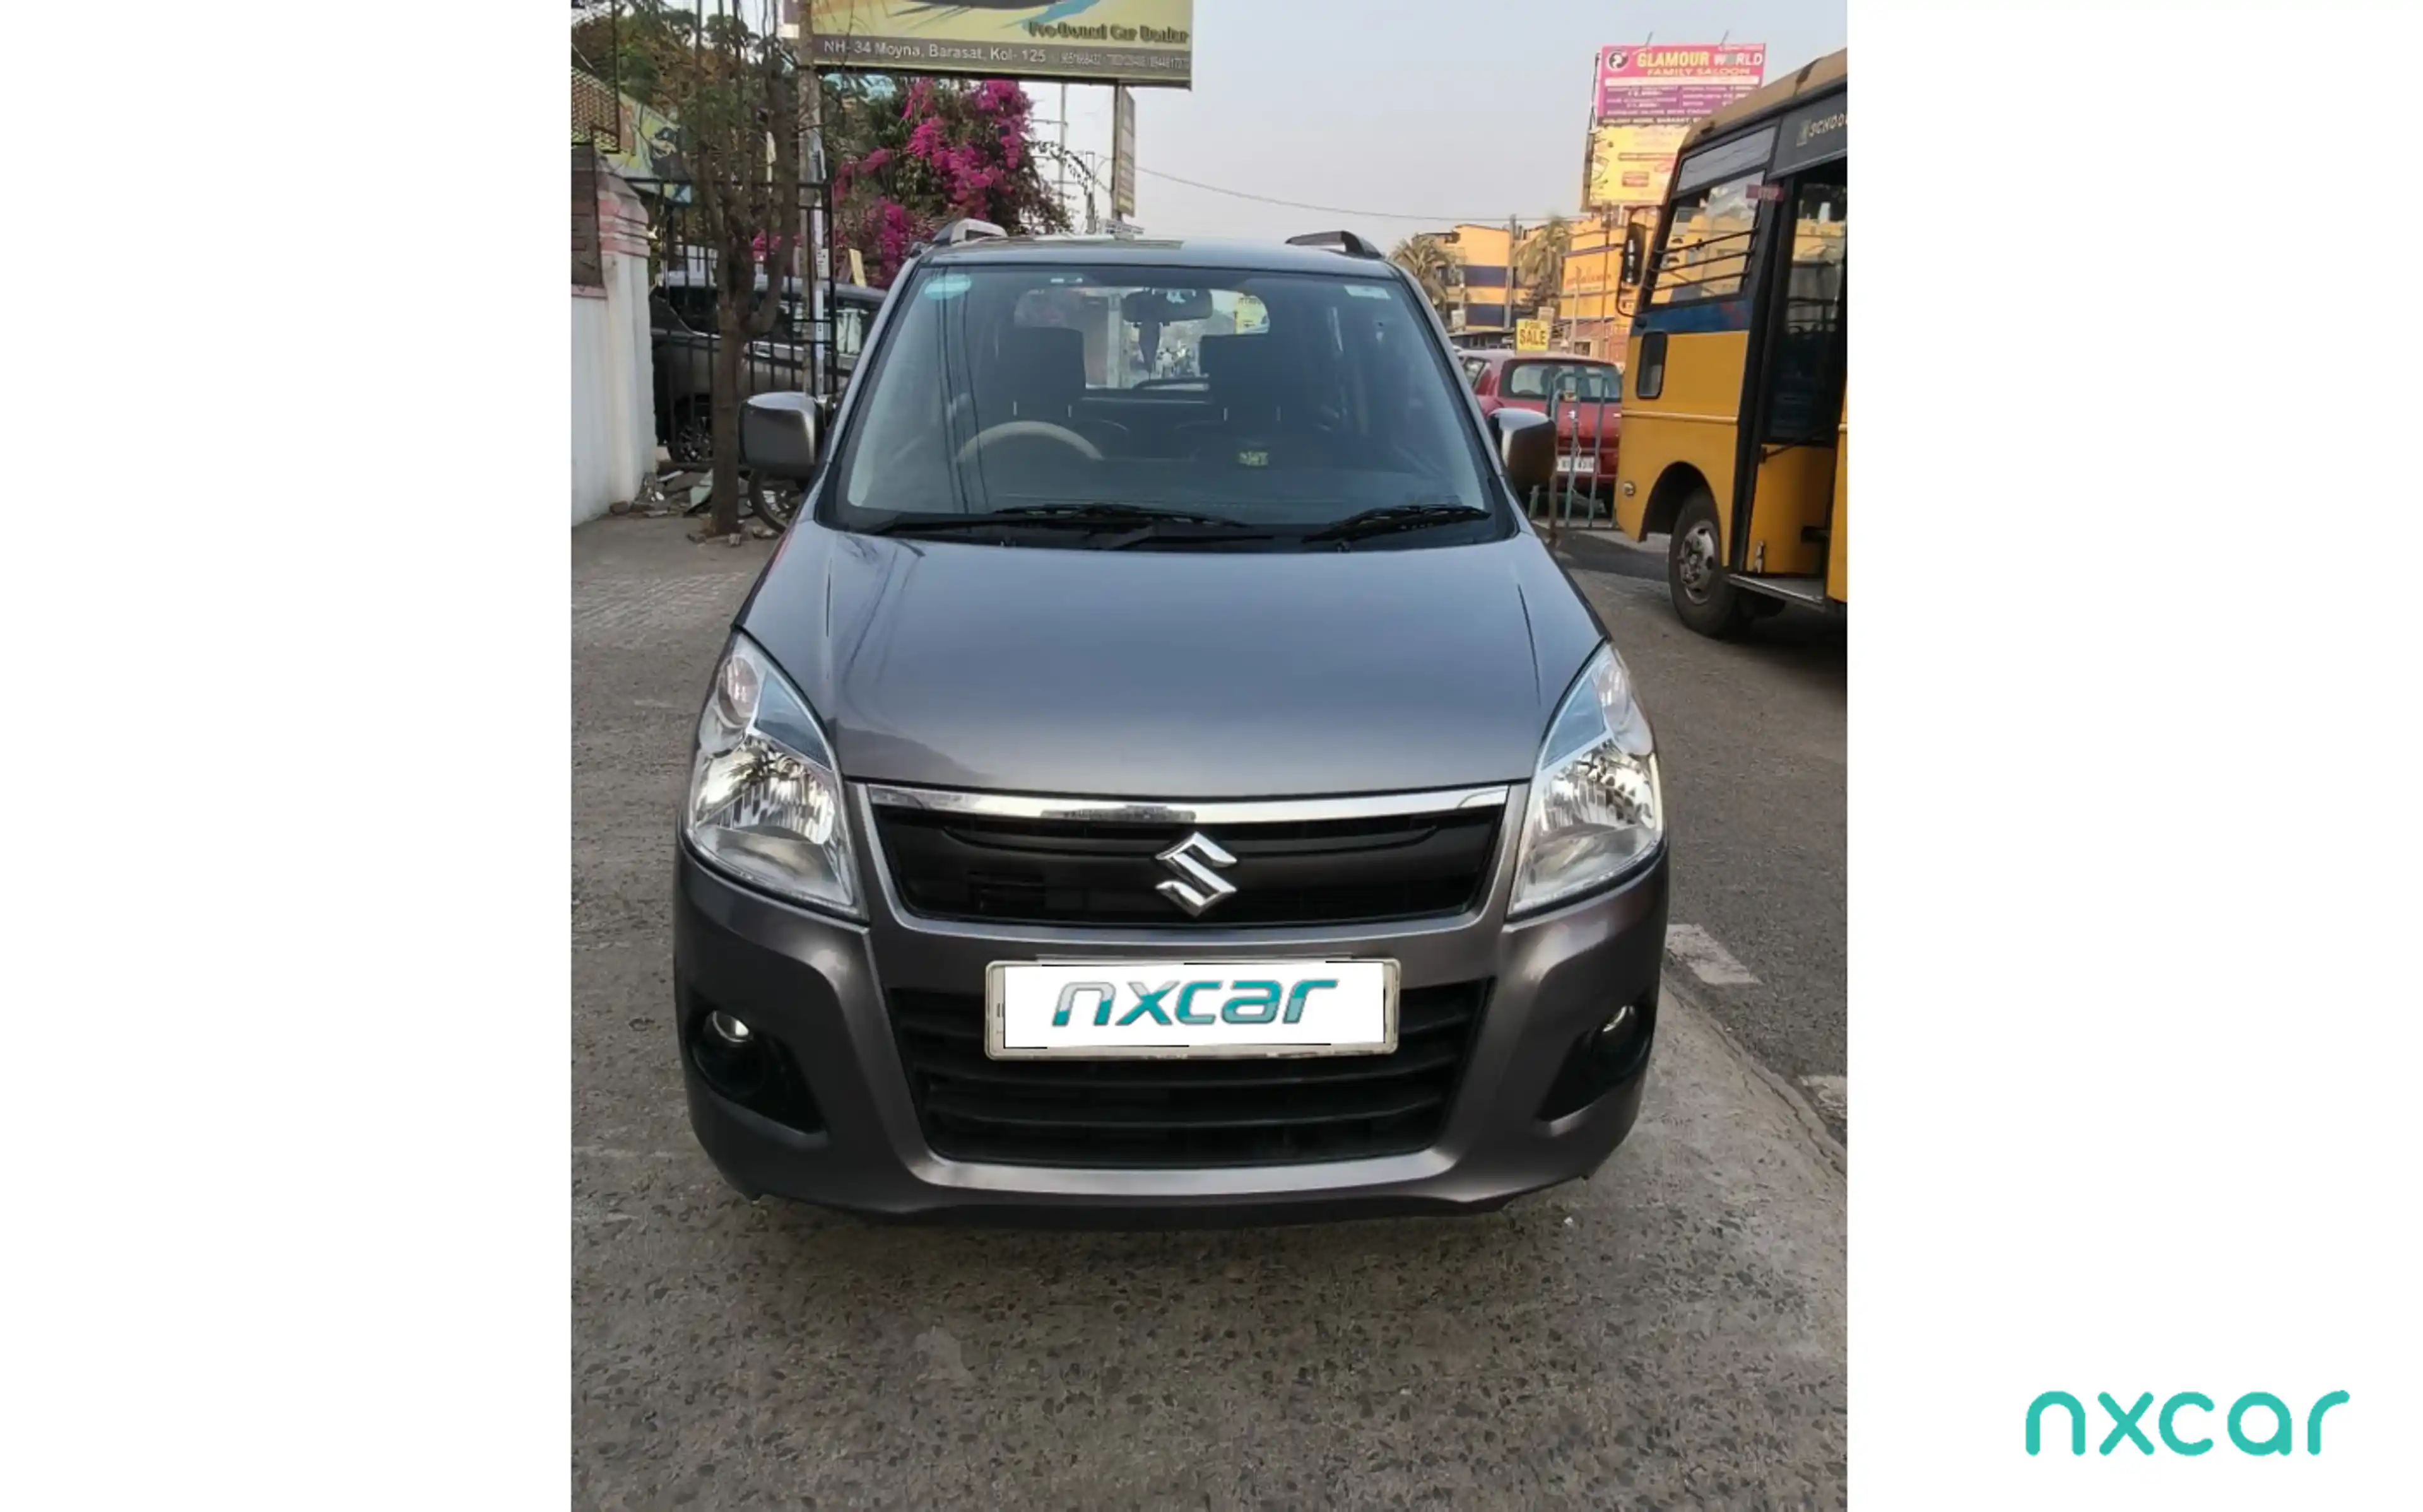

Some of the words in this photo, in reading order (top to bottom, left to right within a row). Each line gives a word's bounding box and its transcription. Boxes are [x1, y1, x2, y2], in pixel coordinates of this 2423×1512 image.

[1110, 23, 1137, 41] Car
[1140, 25, 1189, 44] Dealer
[854, 41, 871, 54] 34
[1022, 49, 1046, 62] 125
[1637, 50, 1710, 67] GLAMOUR
[1647, 67, 1694, 76] FAMILY
[1695, 67, 1751, 76] SALOON
[1808, 112, 1848, 138] SCHOO
[1519, 328, 1547, 346] SALE
